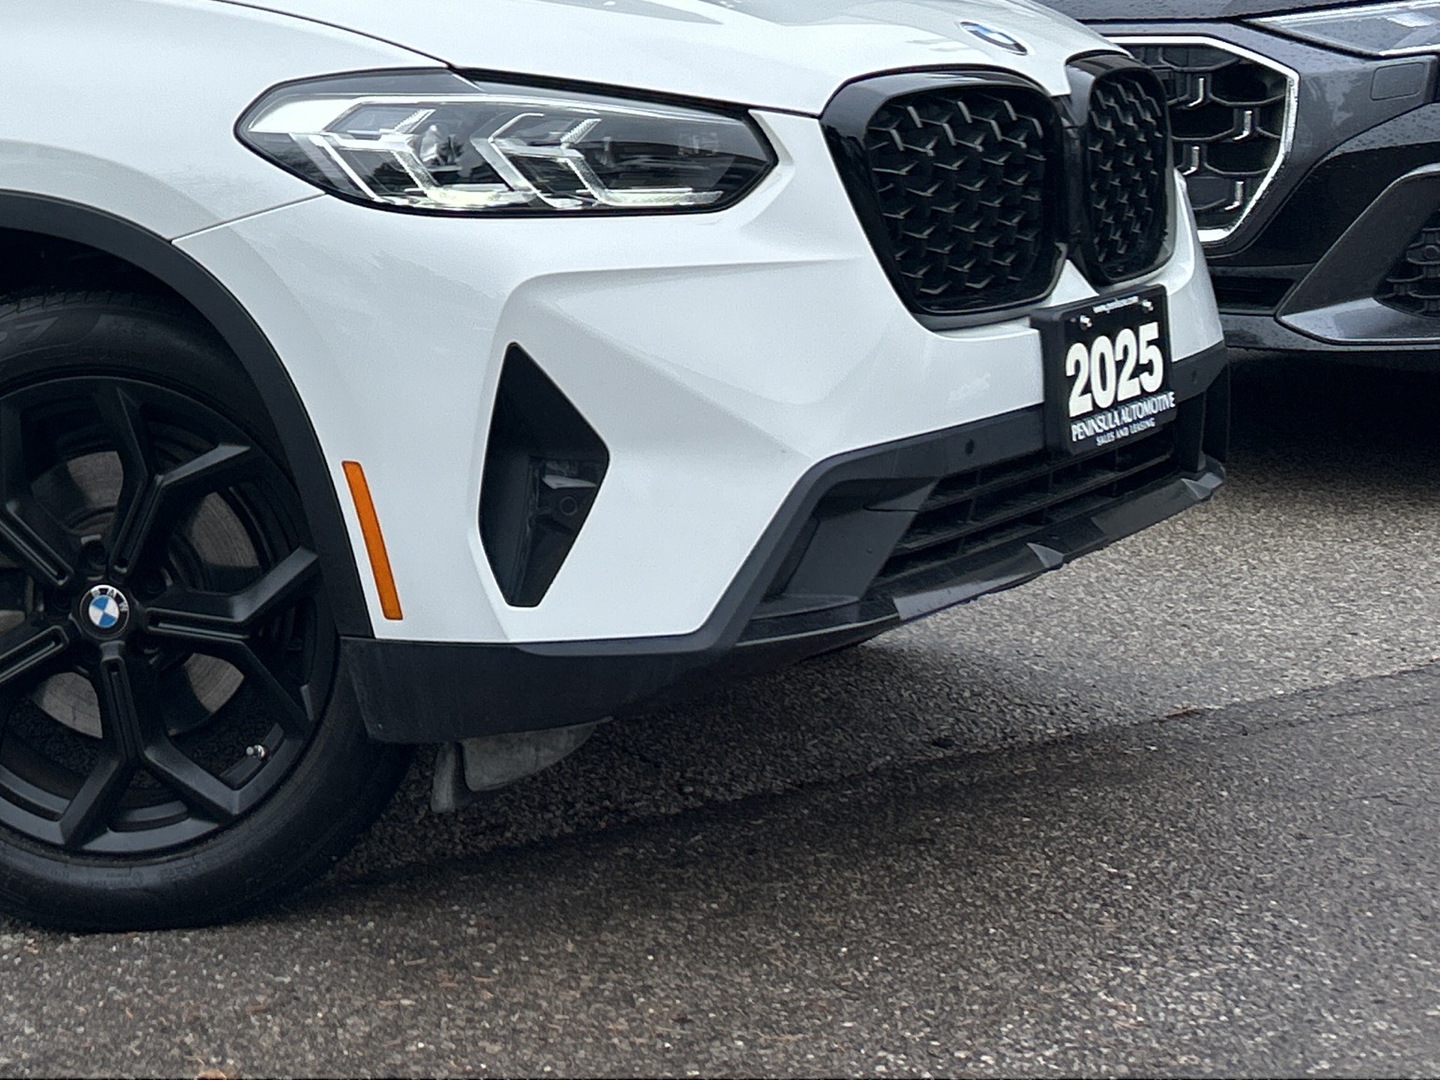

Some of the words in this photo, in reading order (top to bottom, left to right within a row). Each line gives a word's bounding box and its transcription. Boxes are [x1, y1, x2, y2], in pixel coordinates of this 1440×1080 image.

[1065, 321, 1164, 418] 2025
[1071, 409, 1121, 442] PENINSULA
[1121, 391, 1176, 424] AUTOMOTIVE
